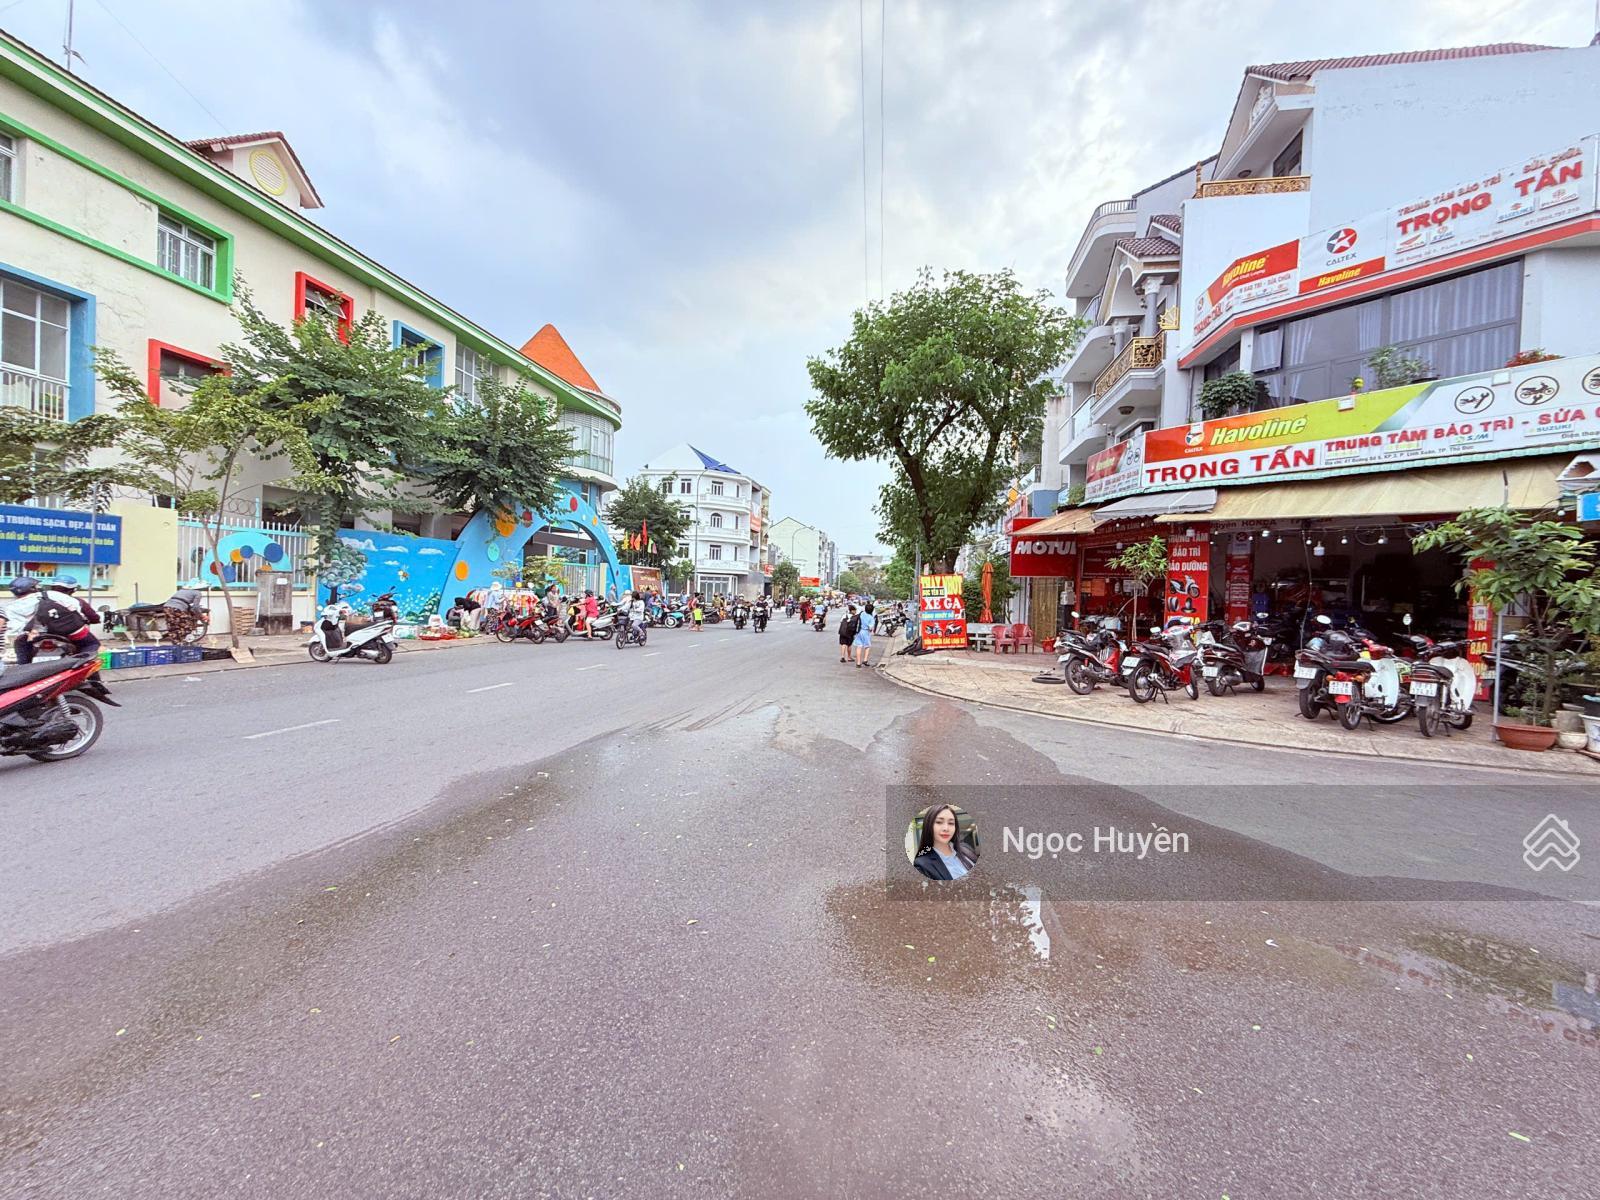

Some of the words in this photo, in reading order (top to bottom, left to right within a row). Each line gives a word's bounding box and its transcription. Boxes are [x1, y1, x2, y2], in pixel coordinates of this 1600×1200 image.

[1396, 191, 1492, 235] TRỌNG
[1514, 160, 1584, 197] TẤN
[1325, 252, 1358, 267] CALTEX
[1316, 267, 1362, 288] Havoline
[1209, 415, 1308, 447] Havoline
[1325, 435, 1382, 452] TRUNG
[1387, 430, 1428, 444] TÂM
[1433, 423, 1473, 439] BẢO
[1479, 415, 1514, 432] TRÌ
[1537, 408, 1586, 425] SỬA
[1535, 423, 1572, 433] SUZUKI
[1145, 458, 1240, 483] TRỌNG
[1249, 444, 1316, 473] TẤN
[1181, 560, 1208, 571] DƯỠNG
[924, 597, 941, 610] XE
[943, 597, 962, 610] GA
